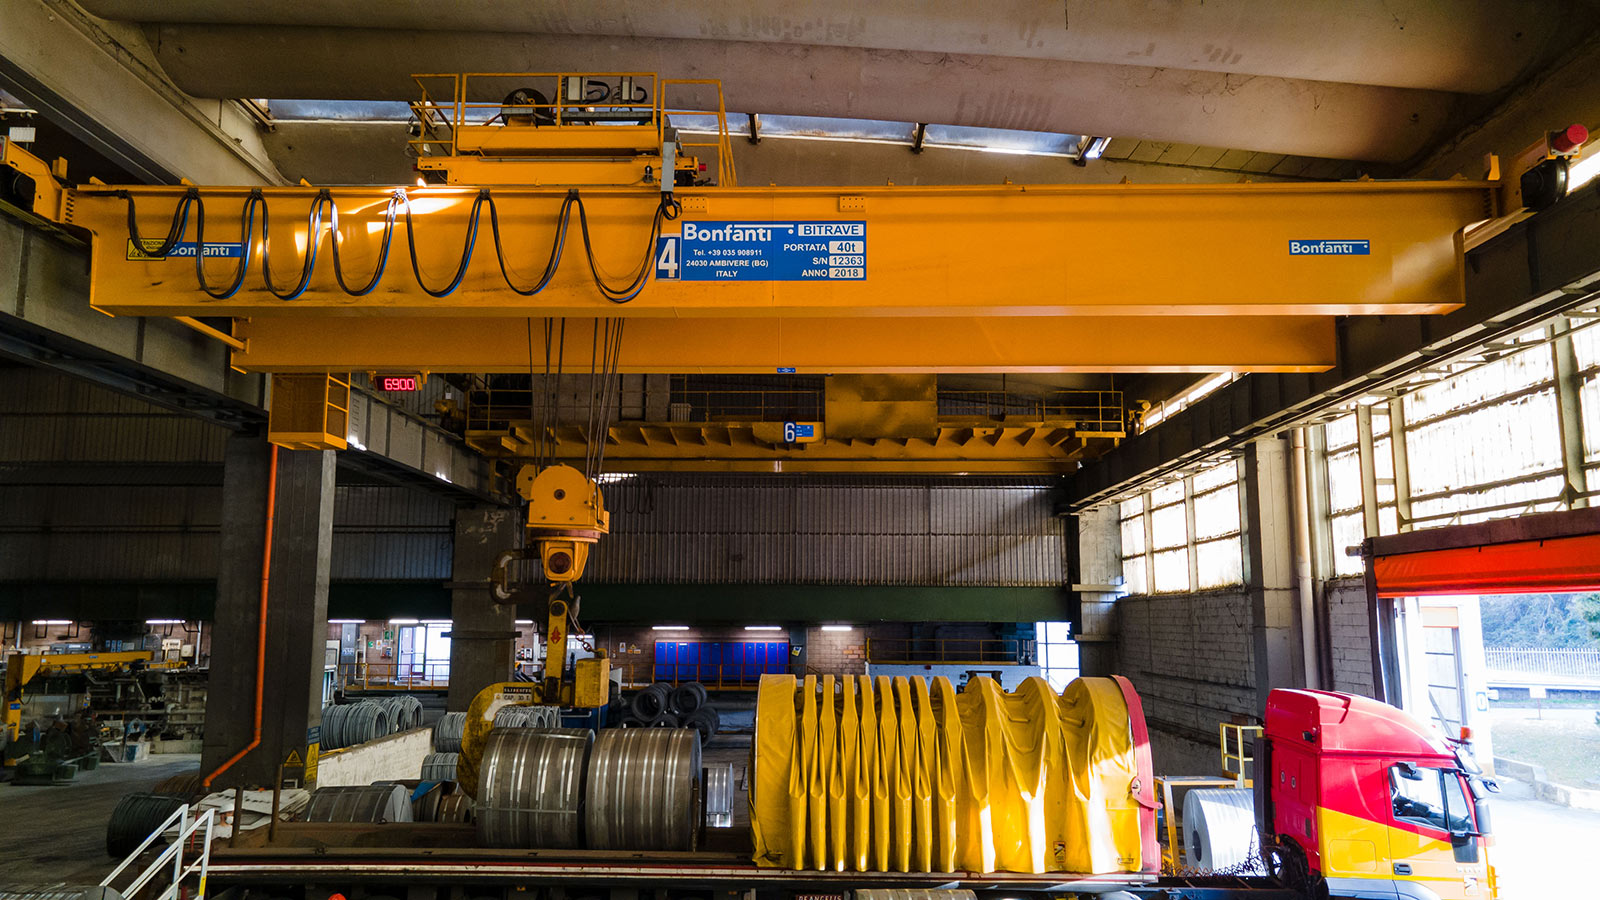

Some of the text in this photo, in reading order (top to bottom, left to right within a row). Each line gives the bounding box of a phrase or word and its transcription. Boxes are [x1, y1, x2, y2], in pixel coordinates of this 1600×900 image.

[684, 223, 772, 242] Bonfanti
[803, 225, 859, 235] BITRAVE
[170, 244, 229, 256] onanti
[783, 242, 856, 252] PORTATA 40t
[1291, 242, 1353, 254] Bonfanti
[658, 238, 678, 278] 4
[751, 260, 769, 268] (BG)
[812, 257, 863, 265] S/N 12363
[801, 269, 859, 277] ANNO 2018
[384, 378, 414, 390] 6900
[785, 422, 795, 442] 6
